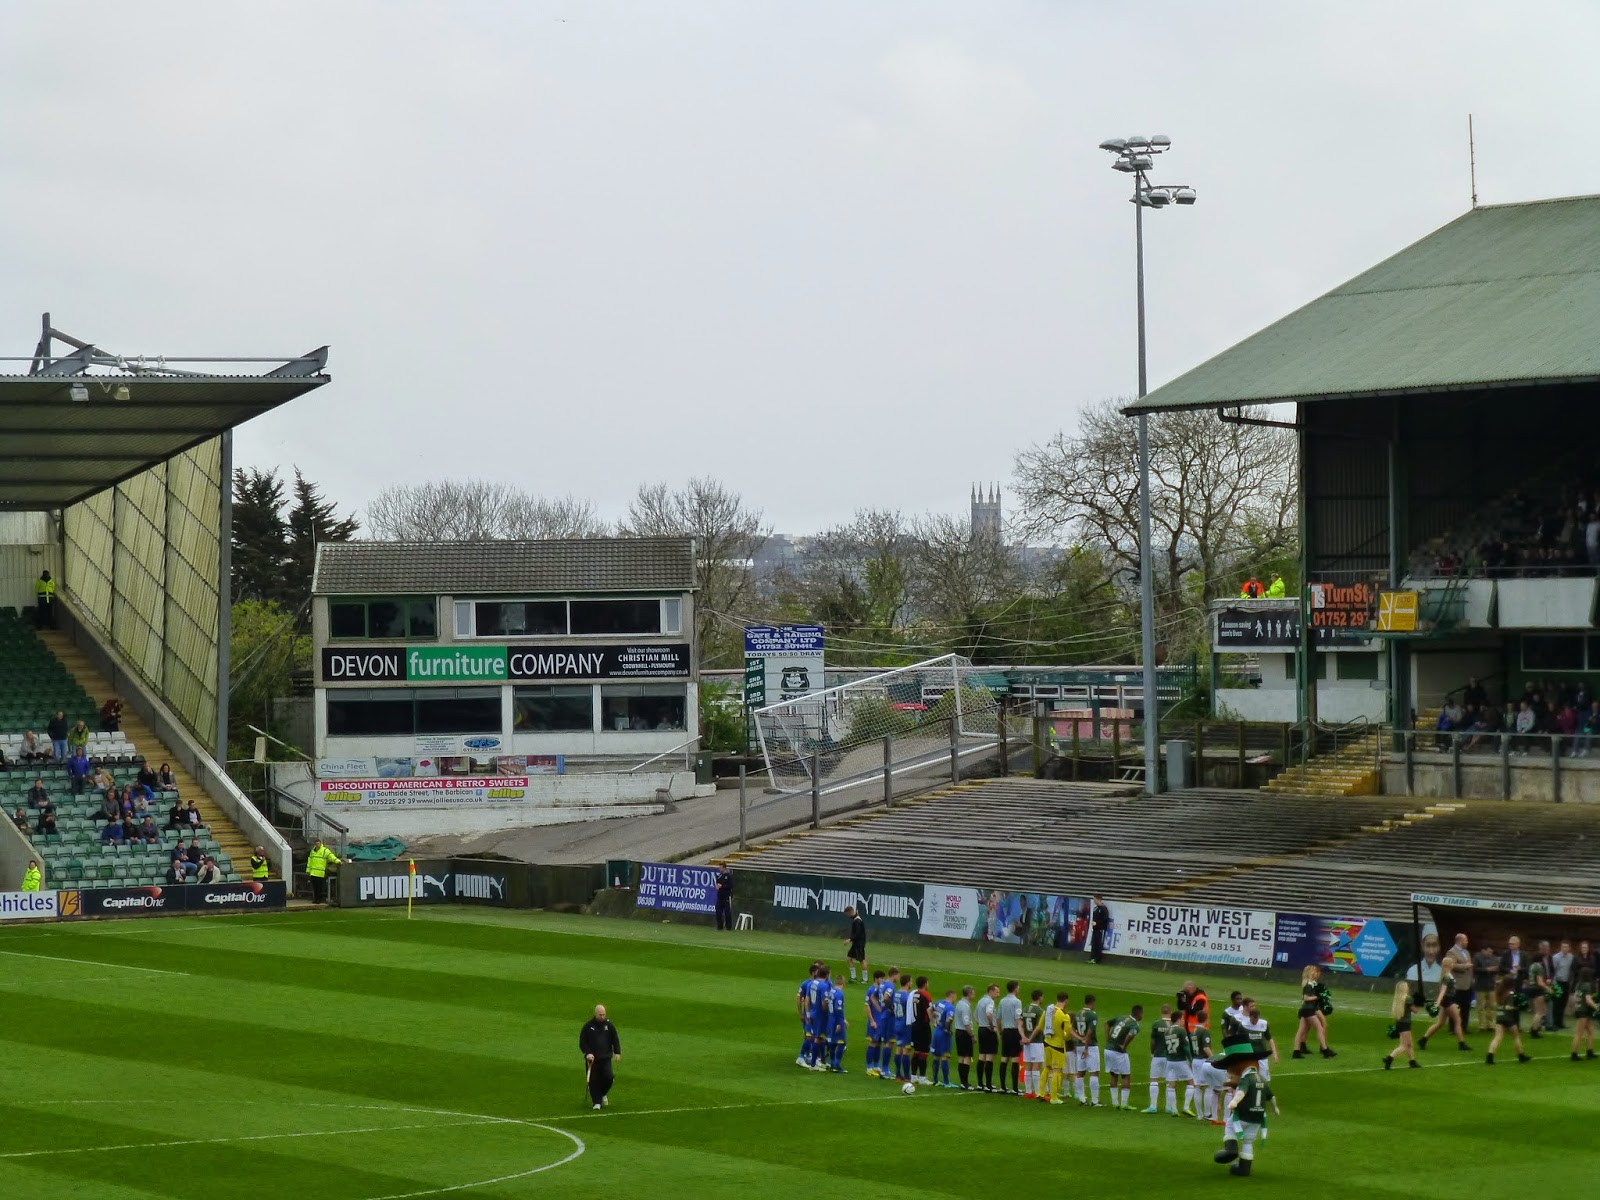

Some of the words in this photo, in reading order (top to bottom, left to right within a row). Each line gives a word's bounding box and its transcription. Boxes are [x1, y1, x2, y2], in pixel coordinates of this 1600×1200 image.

[1313, 612, 1347, 626] 01752
[331, 655, 398, 677] DEVON
[409, 651, 505, 676] furniture
[510, 653, 604, 675] COMPANY
[746, 664, 763, 672] PRIZE
[747, 681, 763, 689] PRIZE
[747, 696, 764, 704] PRIZE
[328, 782, 389, 790] DISCOUNTED
[455, 874, 491, 898] PUMA
[682, 870, 719, 888] STON
[360, 875, 424, 900] PUMA
[659, 885, 706, 900] WORKTOPS
[0, 894, 53, 912] hicles
[773, 885, 808, 909] PUMA
[822, 889, 858, 913] PUMA
[1413, 894, 1439, 903] BOND
[1442, 897, 1478, 906] TIMBER
[871, 894, 908, 918] PUMA
[944, 915, 967, 923] PLYMOUTH
[1146, 906, 1200, 923] SOUTH
[1207, 910, 1252, 926] WEST
[1128, 920, 1171, 935] FIRES
[1218, 926, 1272, 941] FLUES
[1167, 938, 1198, 947] 01752
[1211, 943, 1242, 952] 08151
[1166, 1038, 1180, 1054] 27
[1256, 1090, 1261, 1106] 1
